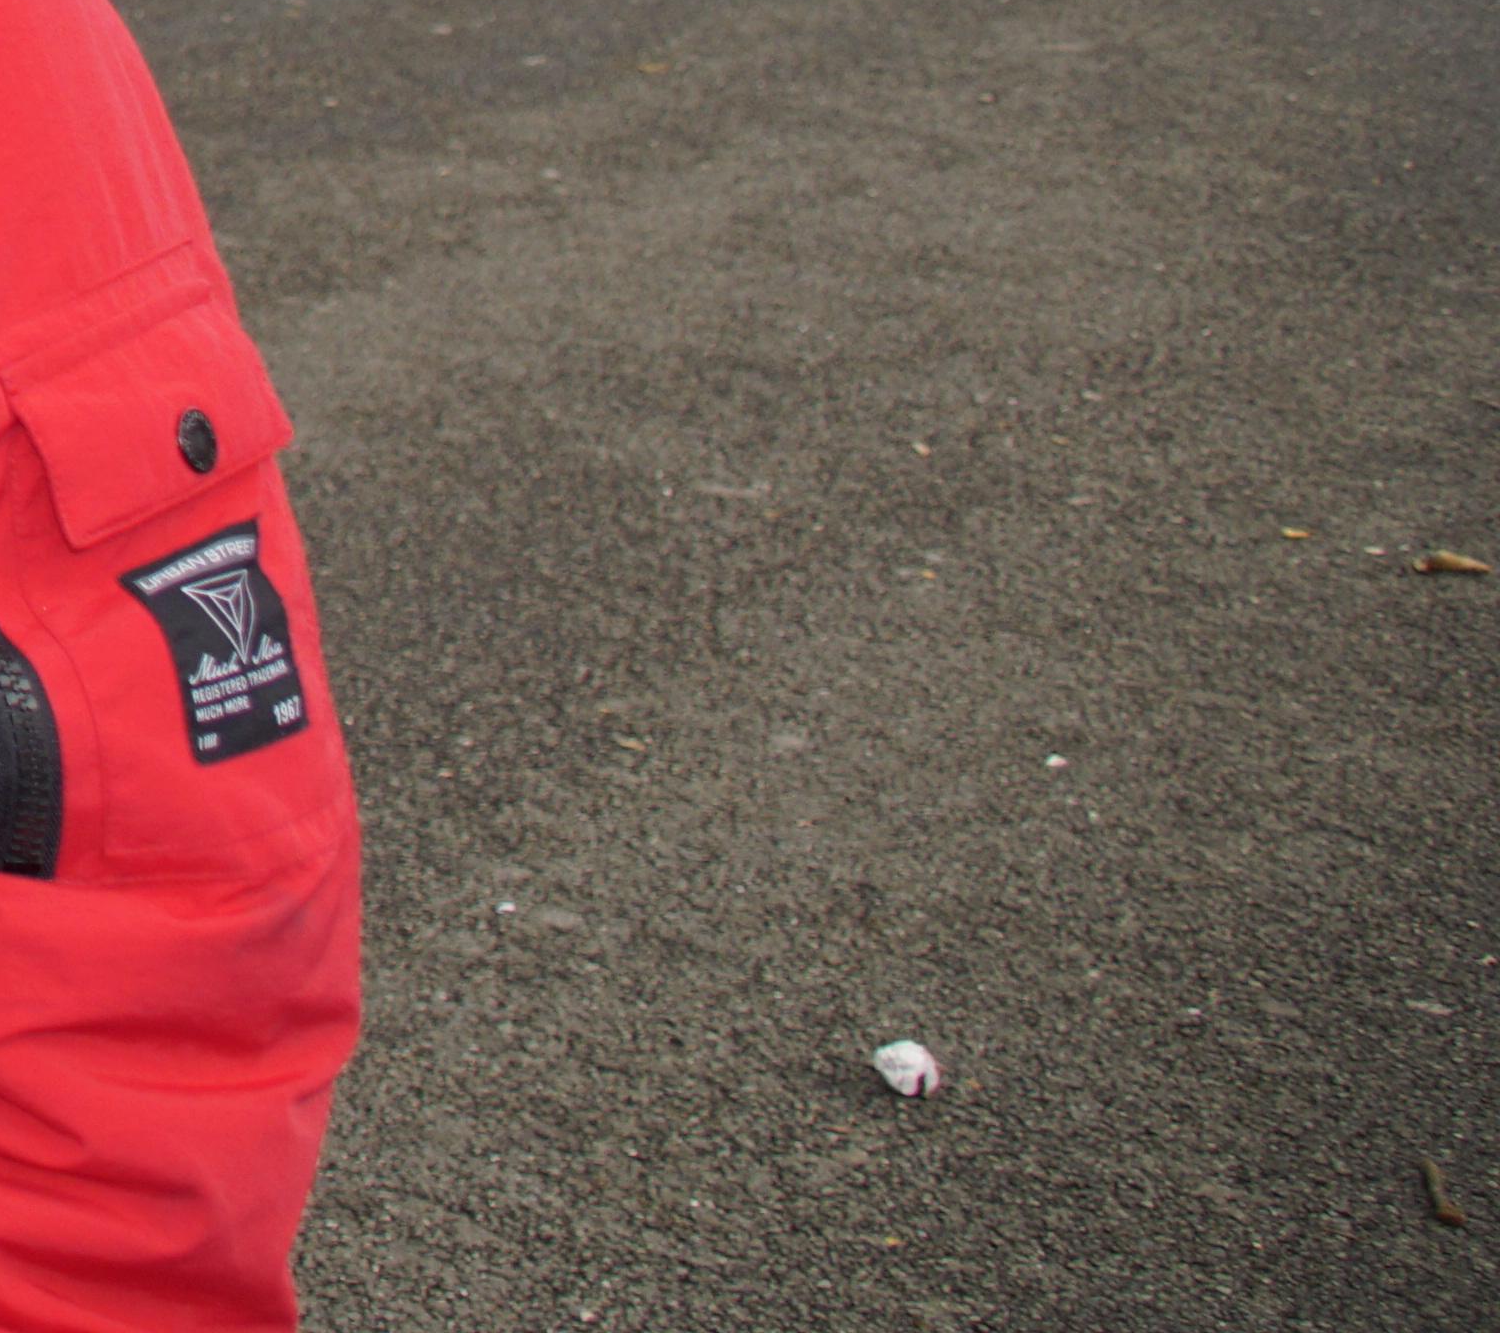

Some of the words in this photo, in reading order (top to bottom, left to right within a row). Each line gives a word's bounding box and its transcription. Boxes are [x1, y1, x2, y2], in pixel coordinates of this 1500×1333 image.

[190, 674, 248, 705] REGISTERED
[195, 703, 224, 723] MUCH
[222, 694, 251, 715] MORE
